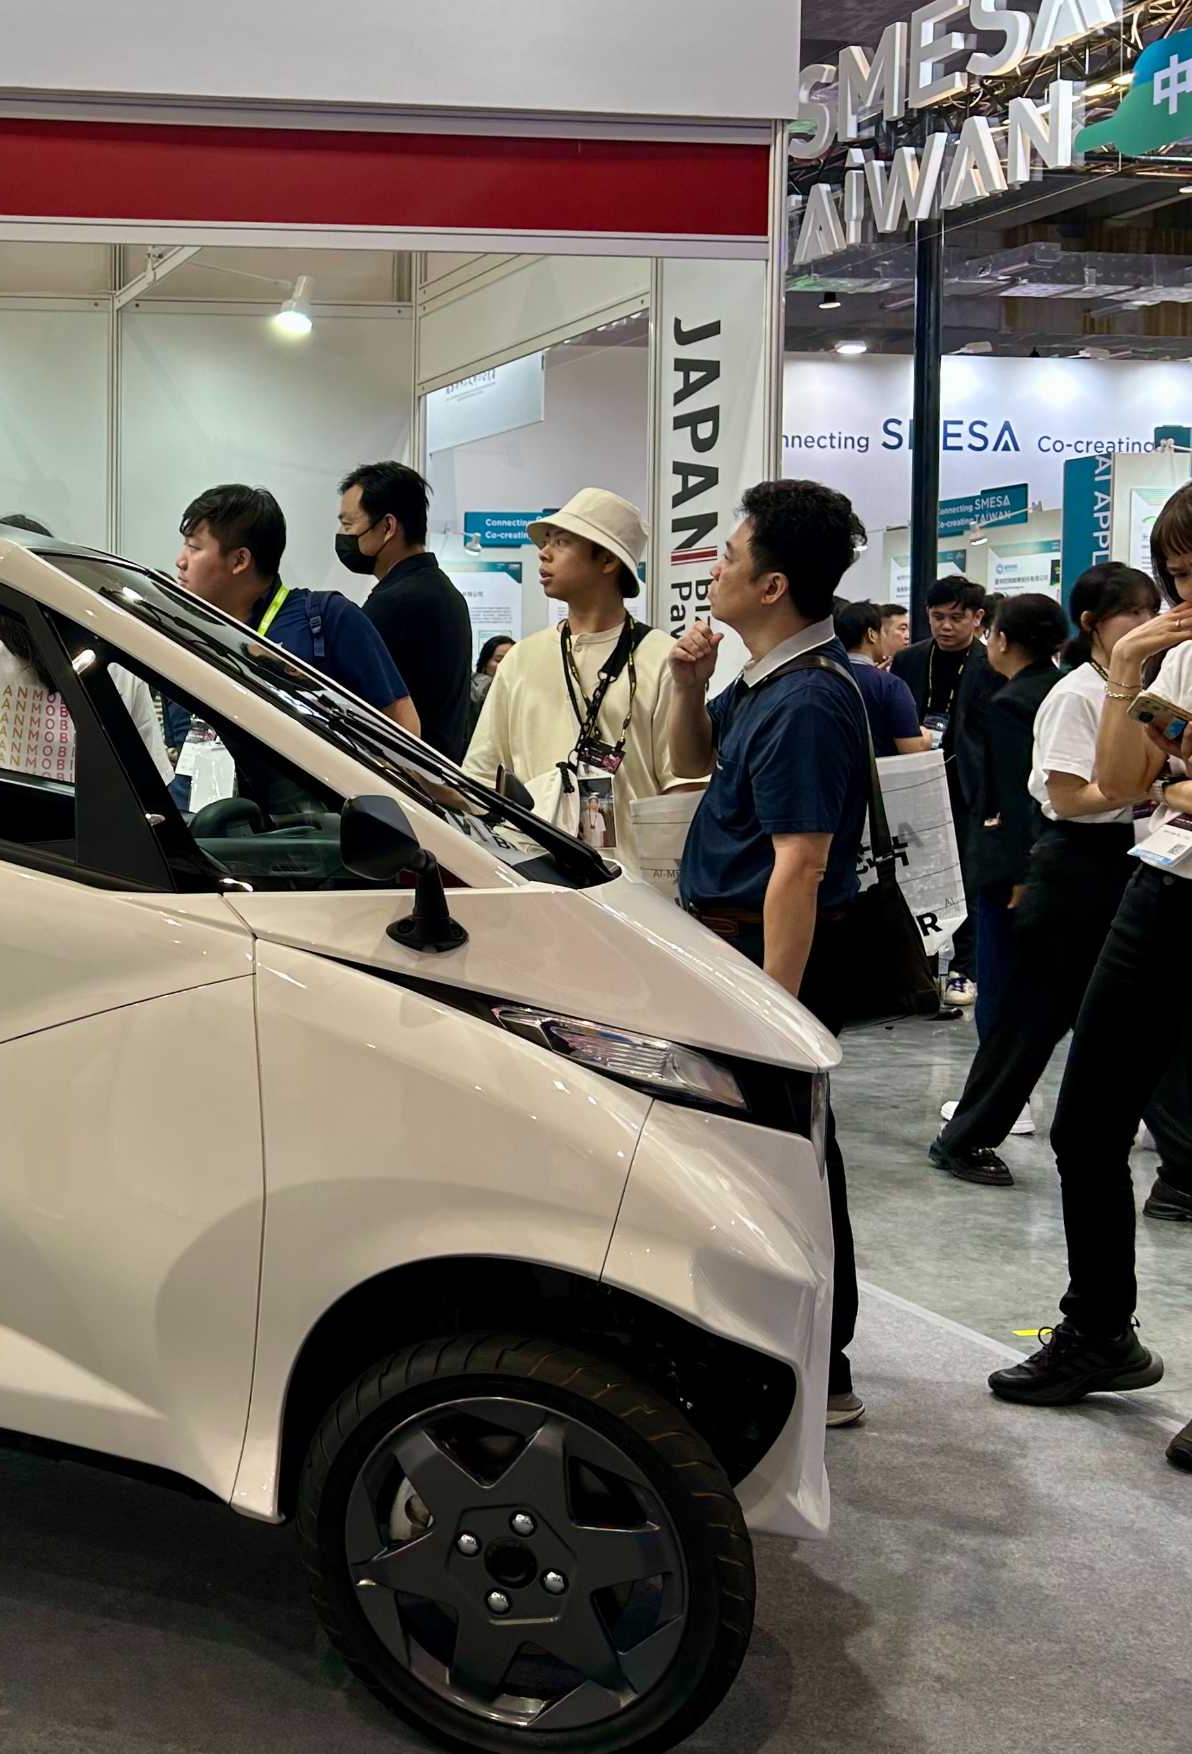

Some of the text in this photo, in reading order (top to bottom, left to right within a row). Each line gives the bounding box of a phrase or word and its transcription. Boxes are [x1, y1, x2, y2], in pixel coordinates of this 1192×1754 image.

[670, 316, 722, 566] JAPAN
[974, 495, 1011, 510] SMESA
[485, 518, 529, 527] Connectin
[485, 531, 529, 539] Co-creatin
